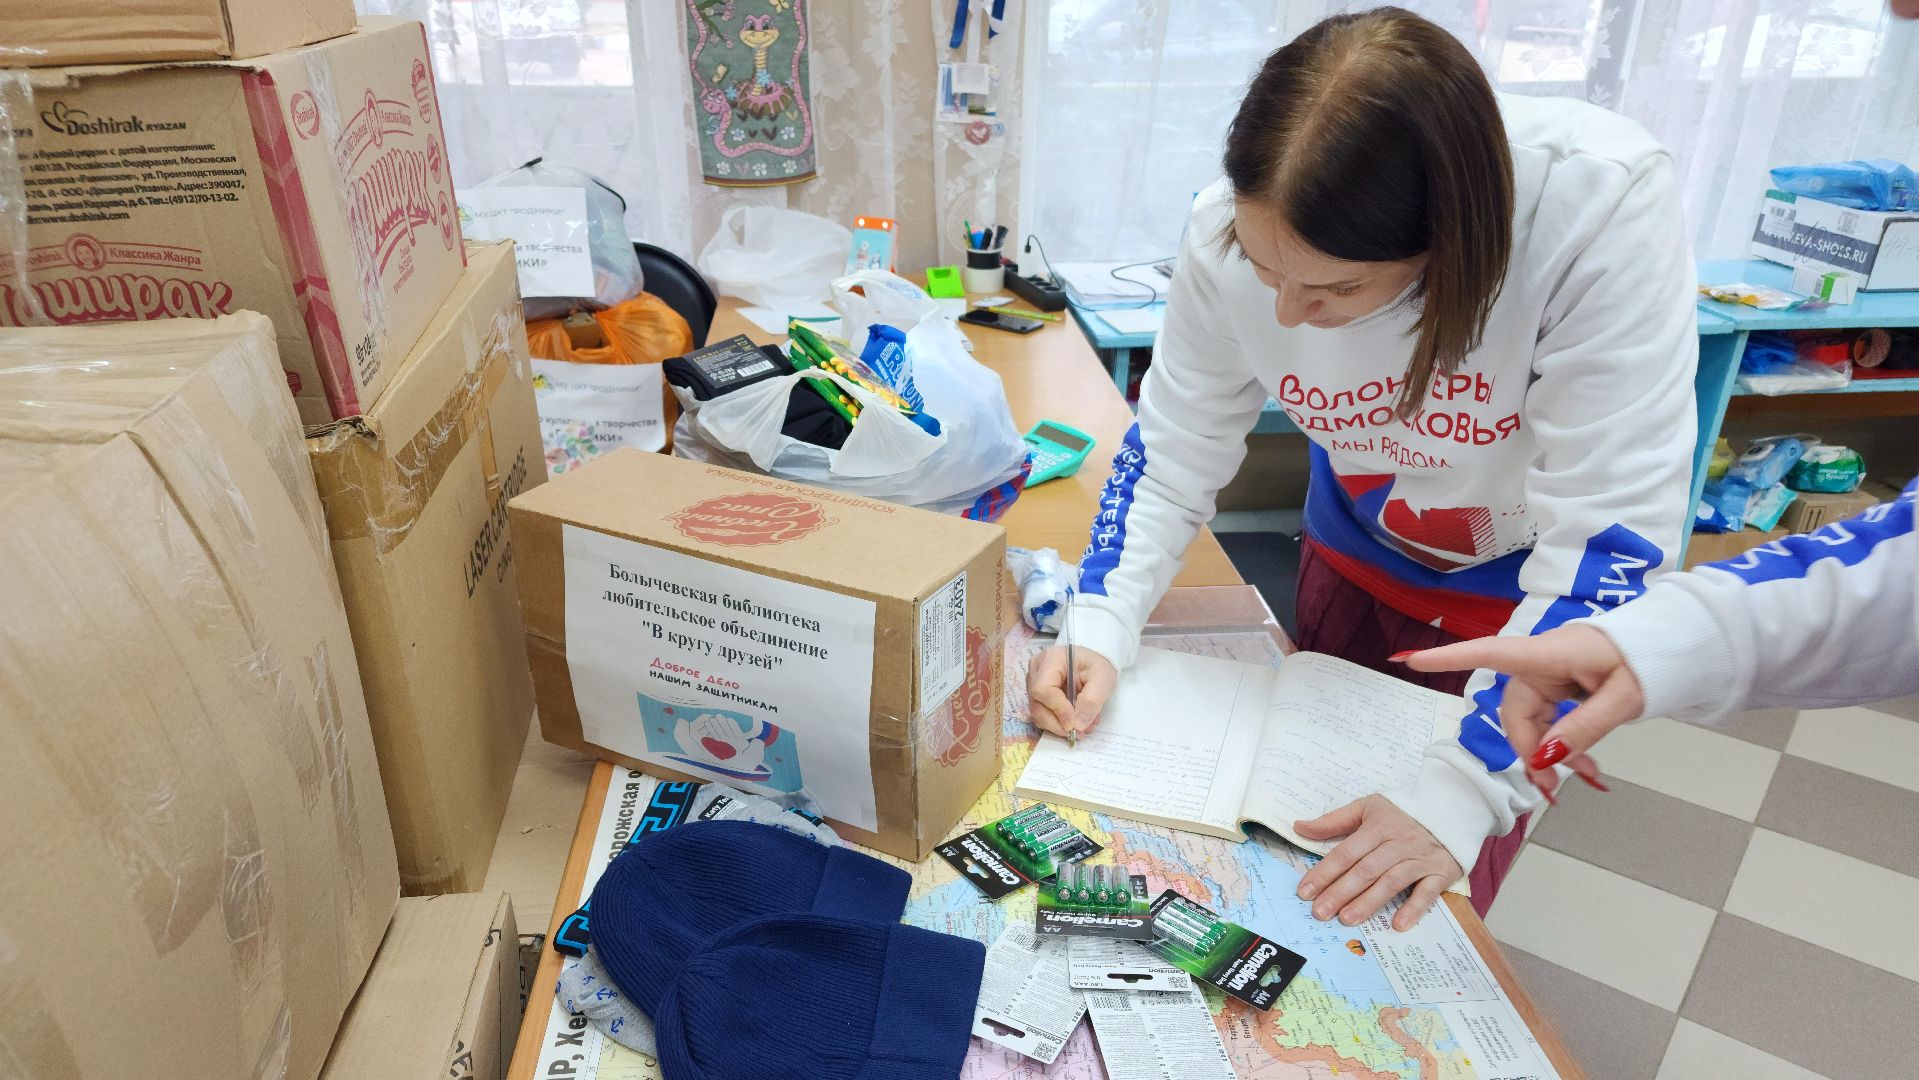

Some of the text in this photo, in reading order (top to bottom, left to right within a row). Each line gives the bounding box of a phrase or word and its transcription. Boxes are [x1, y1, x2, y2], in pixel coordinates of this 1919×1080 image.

[66, 115, 186, 136] Doshirak RYAZAN
[121, 158, 180, 169] Федерация,
[180, 155, 236, 165] Московская
[148, 144, 216, 153] изготовления:
[156, 168, 247, 181] Производственная,
[208, 179, 245, 190] 390047,
[109, 247, 201, 265] Классика Жанра
[1279, 369, 1496, 411] ВОЛОНЕРЫ
[603, 418, 657, 429] творчества
[1332, 436, 1453, 469] МЫ РЯДОМ
[705, 467, 896, 514] КОНДИТЕРСКАЯ ФАБРИКА
[464, 519, 494, 600] LASER
[608, 563, 821, 633] Болычевская библиотека
[954, 578, 965, 621] 2403
[602, 590, 829, 660] любительское объединение
[642, 620, 783, 671] "В кругу друзей"
[649, 657, 740, 690] ДОБРОЕ ДЕЛО
[649, 669, 779, 714] НАШИМ ЗАЩИТНИКАМ
[994, 640, 1002, 761] КОНДИТЕРСКАЯ
[703, 802, 723, 818] Katy
[942, 846, 957, 857] AA
[961, 839, 1021, 885] Camelion
[1046, 914, 1144, 928] Camelion
[1229, 943, 1278, 991] Camelion
[1254, 989, 1271, 1005] AAA
[1025, 1026, 1064, 1045] Camelion
